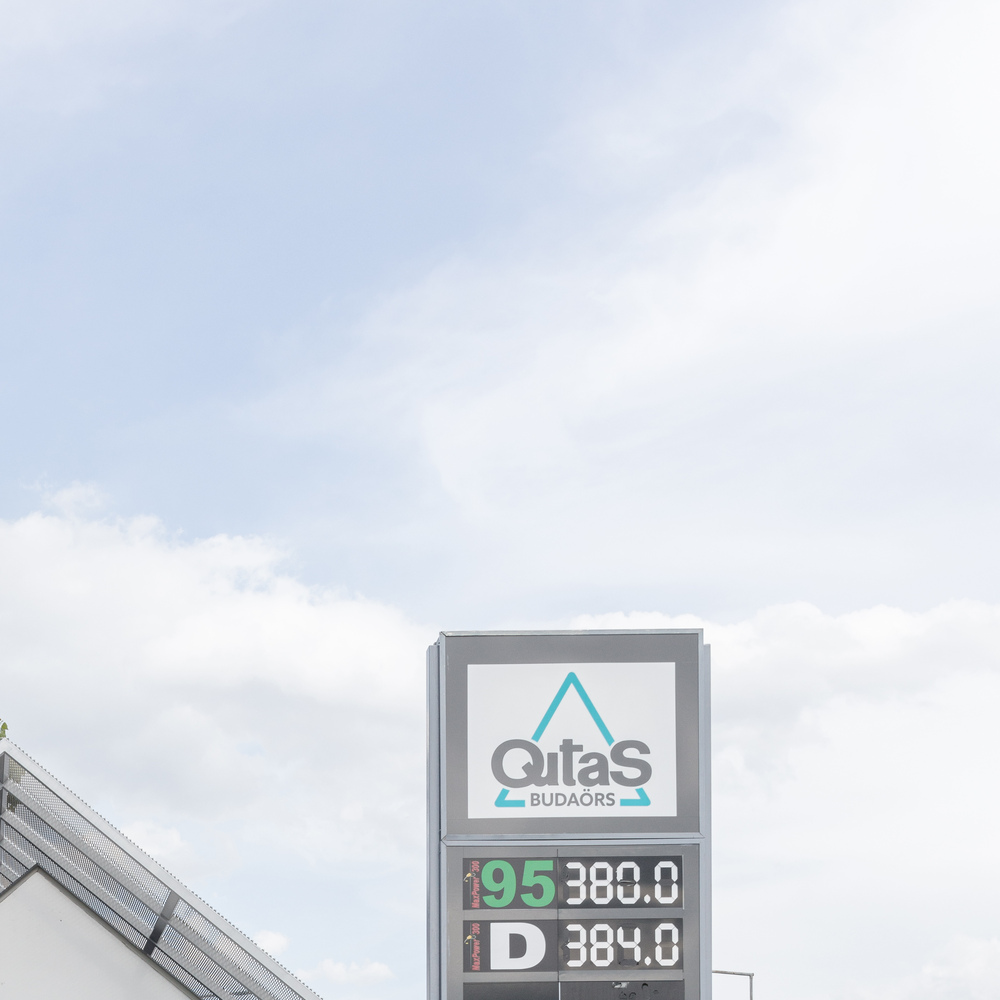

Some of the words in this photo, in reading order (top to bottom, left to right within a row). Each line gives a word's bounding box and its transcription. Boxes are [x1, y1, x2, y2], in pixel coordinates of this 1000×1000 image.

[530, 788, 616, 807] BUDAÖRS
[471, 860, 480, 872] 300
[471, 876, 480, 908] MaxPower
[481, 859, 556, 908] 95
[565, 861, 678, 904] 380.0
[472, 923, 480, 935] 300
[565, 923, 679, 967] 384.0
[472, 939, 480, 971] MaxPower
[490, 922, 546, 970] D
